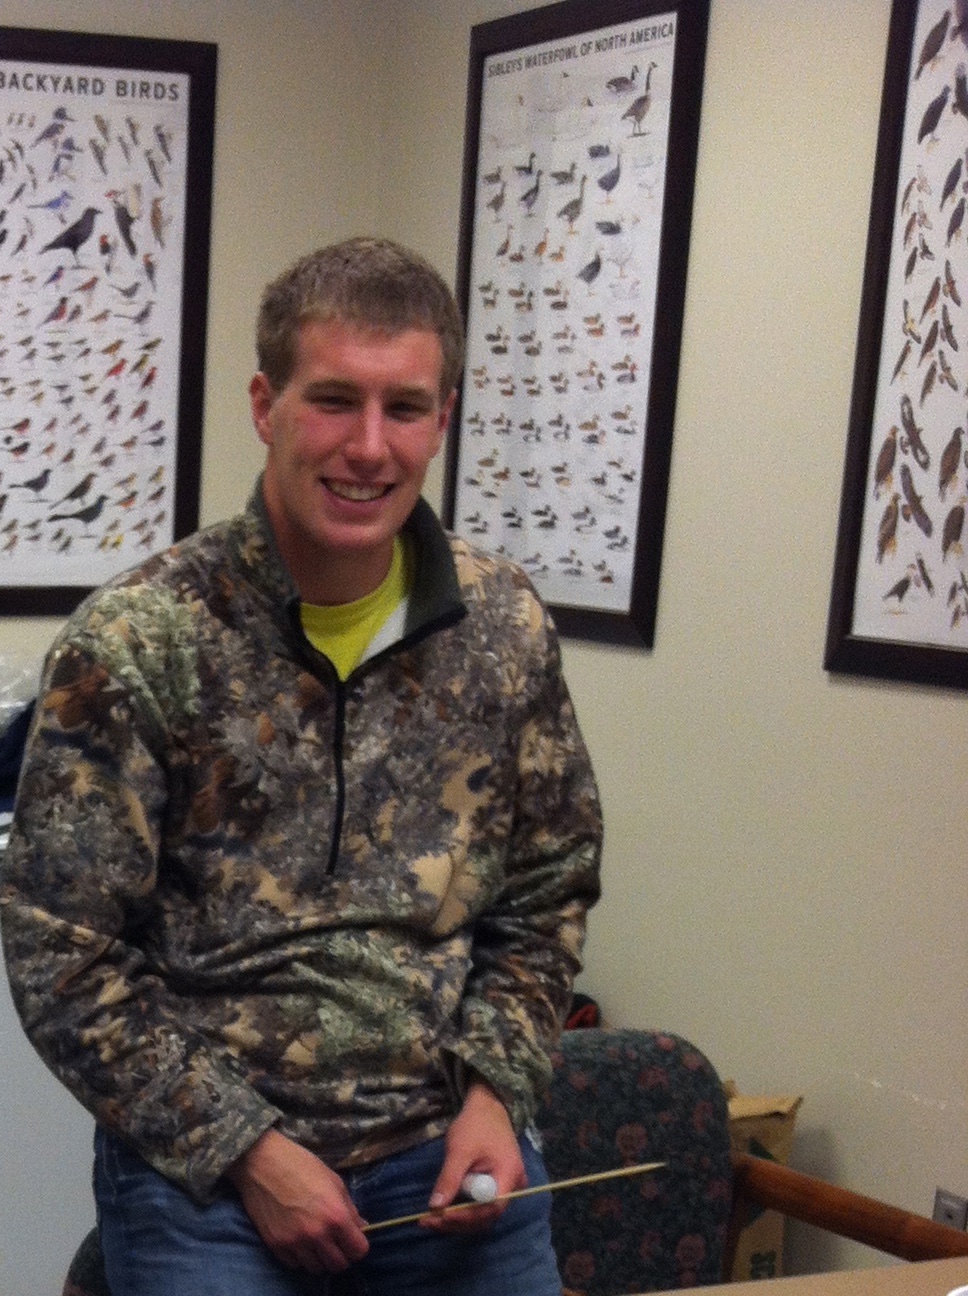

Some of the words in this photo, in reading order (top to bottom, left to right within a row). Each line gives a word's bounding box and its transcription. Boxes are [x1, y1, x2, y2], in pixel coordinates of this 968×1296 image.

[525, 45, 578, 68] WATERFOWL
[580, 41, 593, 56] OF
[595, 33, 627, 52] NORTH
[629, 22, 674, 46] AMERICA
[114, 80, 180, 101] BIRDS
